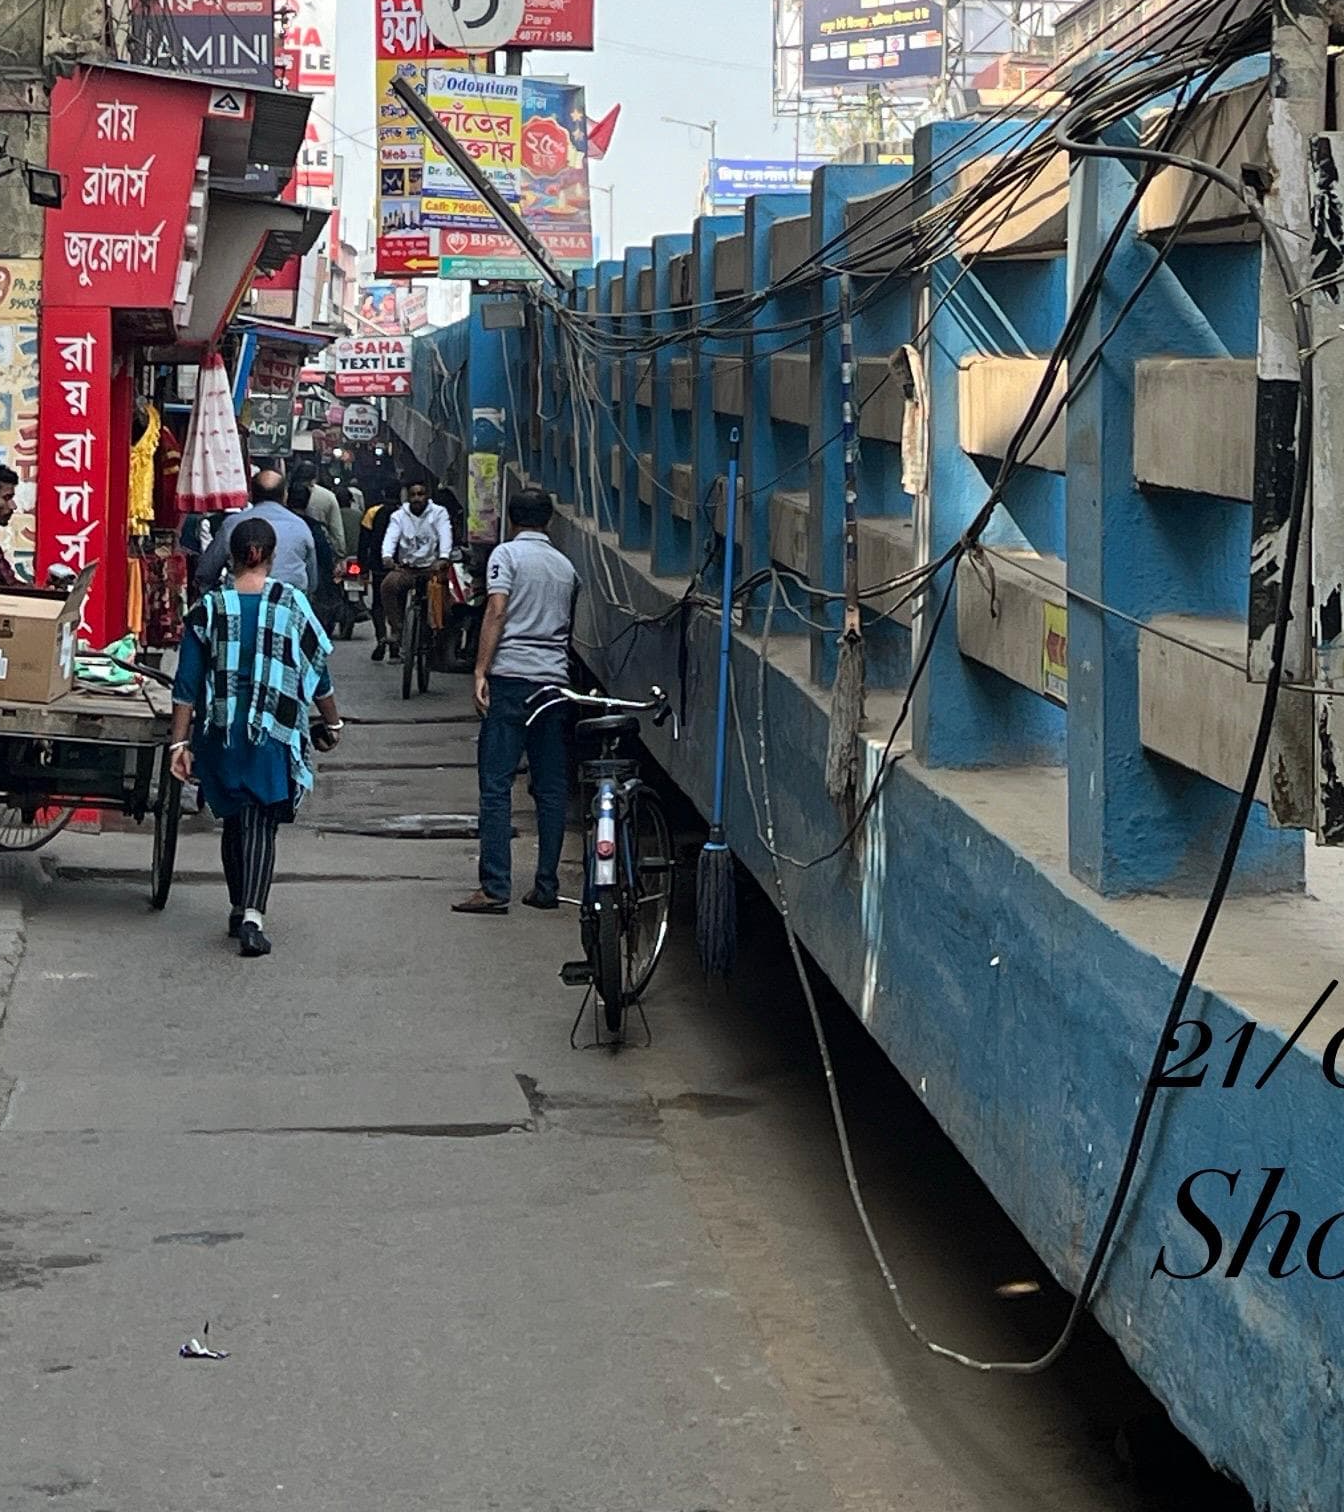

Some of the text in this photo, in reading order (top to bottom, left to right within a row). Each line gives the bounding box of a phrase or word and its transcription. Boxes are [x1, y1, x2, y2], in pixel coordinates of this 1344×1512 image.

[447, 76, 519, 97] Odontium
[97, 99, 138, 142] রায়
[82, 154, 156, 208] ব্রাদার্স
[64, 221, 166, 287] জুয়েলার্স
[339, 355, 406, 370] TEXTILE
[354, 341, 404, 354] SAHA
